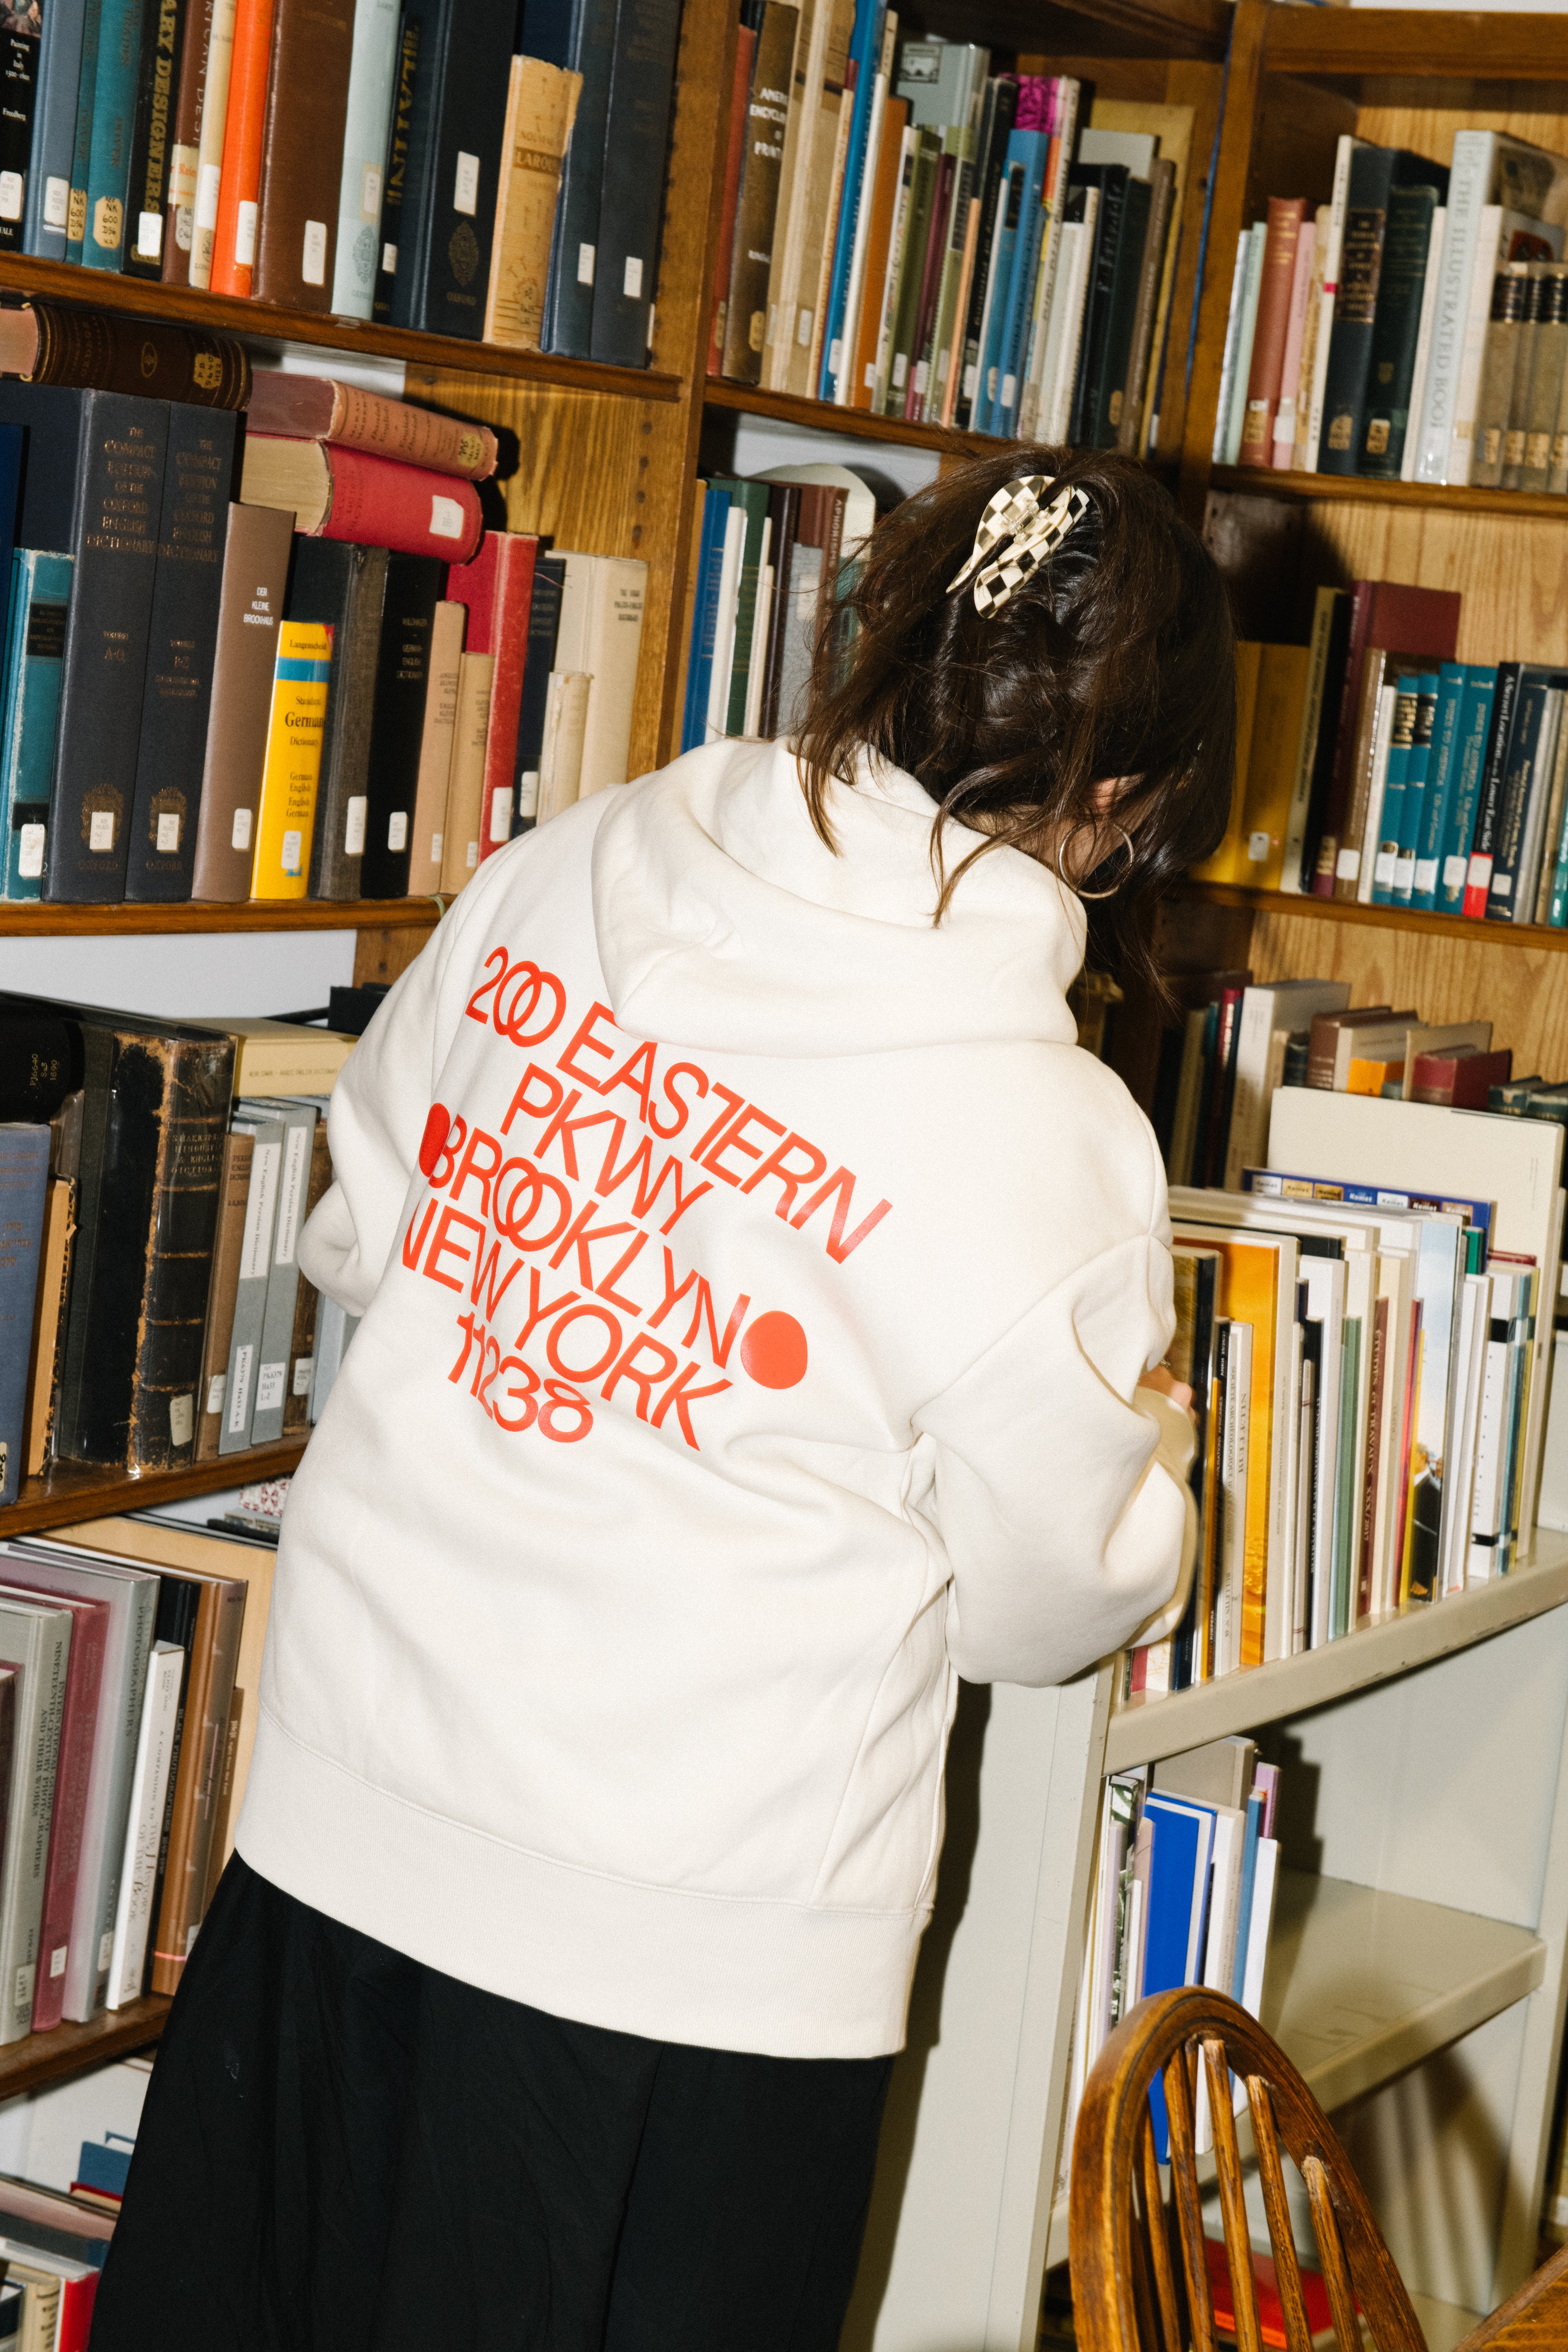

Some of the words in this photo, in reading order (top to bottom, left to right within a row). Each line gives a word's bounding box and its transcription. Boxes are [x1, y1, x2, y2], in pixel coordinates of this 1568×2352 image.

[3, 107, 27, 122] Freedberg
[144, 56, 172, 213] DESIGNERS
[102, 214, 118, 224] 600
[105, 203, 118, 213] NK
[1437, 226, 1469, 373] ILLUSTRATED
[130, 427, 144, 438] THE
[200, 439, 213, 450] THE
[104, 440, 156, 459] COMPACT
[176, 452, 222, 470] COMPACT
[130, 483, 144, 494] THE
[103, 497, 149, 514] OXFORD
[174, 509, 215, 525] OXFORD
[102, 516, 147, 534] ENGLISH
[173, 526, 212, 543] ENGLISH
[828, 498, 844, 568] APHORISMS
[86, 534, 155, 554] DICTIONARY
[158, 543, 218, 563] DICTIONARY
[257, 587, 267, 596] DER
[252, 601, 270, 612] KLEINE
[243, 614, 274, 626] BROCKHAUS
[1504, 673, 1515, 683] A
[1499, 682, 1514, 715] Secret
[284, 711, 325, 728] German
[290, 735, 319, 747] Dictionary
[1494, 715, 1511, 759] Location
[289, 782, 311, 793] English
[290, 771, 312, 781] German
[288, 797, 310, 807] English
[1487, 777, 1500, 808] Lower
[286, 808, 309, 818] German
[1483, 809, 1495, 829] East
[1480, 829, 1492, 853] Side
[145, 861, 183, 871] OXFORD
[30, 1053, 38, 1086] PJ6640
[465, 946, 567, 1047] 200
[555, 1001, 893, 1264] EASTERN
[262, 1149, 270, 1167] New
[500, 1062, 715, 1236] PKWY
[259, 1169, 267, 1198] English
[1349, 1192, 1373, 1203] Kemet
[255, 1201, 264, 1231] Persian
[282, 1216, 292, 1257] Dictionary
[427, 1112, 751, 1370] BROOKLYN
[250, 1233, 260, 1275] Dictionary
[514, 1266, 734, 1452] YORK
[1372, 1328, 1383, 1386] ÉTUDES
[447, 1310, 594, 1443] 11238
[1238, 1392, 1247, 1474] BULLETIN
[1367, 1411, 1376, 1475] TRAVAUX
[125, 1606, 143, 1738] PHOTOGRAPHERS
[43, 1641, 62, 1773] NINETEENTH-CENTURY
[49, 1680, 65, 1765] INTERNATIONAL
[36, 1728, 45, 1773] THEIR
[150, 1740, 164, 1802] COMPANION
[32, 1775, 42, 1817] WORKS
[163, 1744, 180, 1832] PHOTOGRAPHERS
[33, 1776, 49, 1879] PHOTOGRAPHERS
[129, 1879, 146, 1924] BOOK
